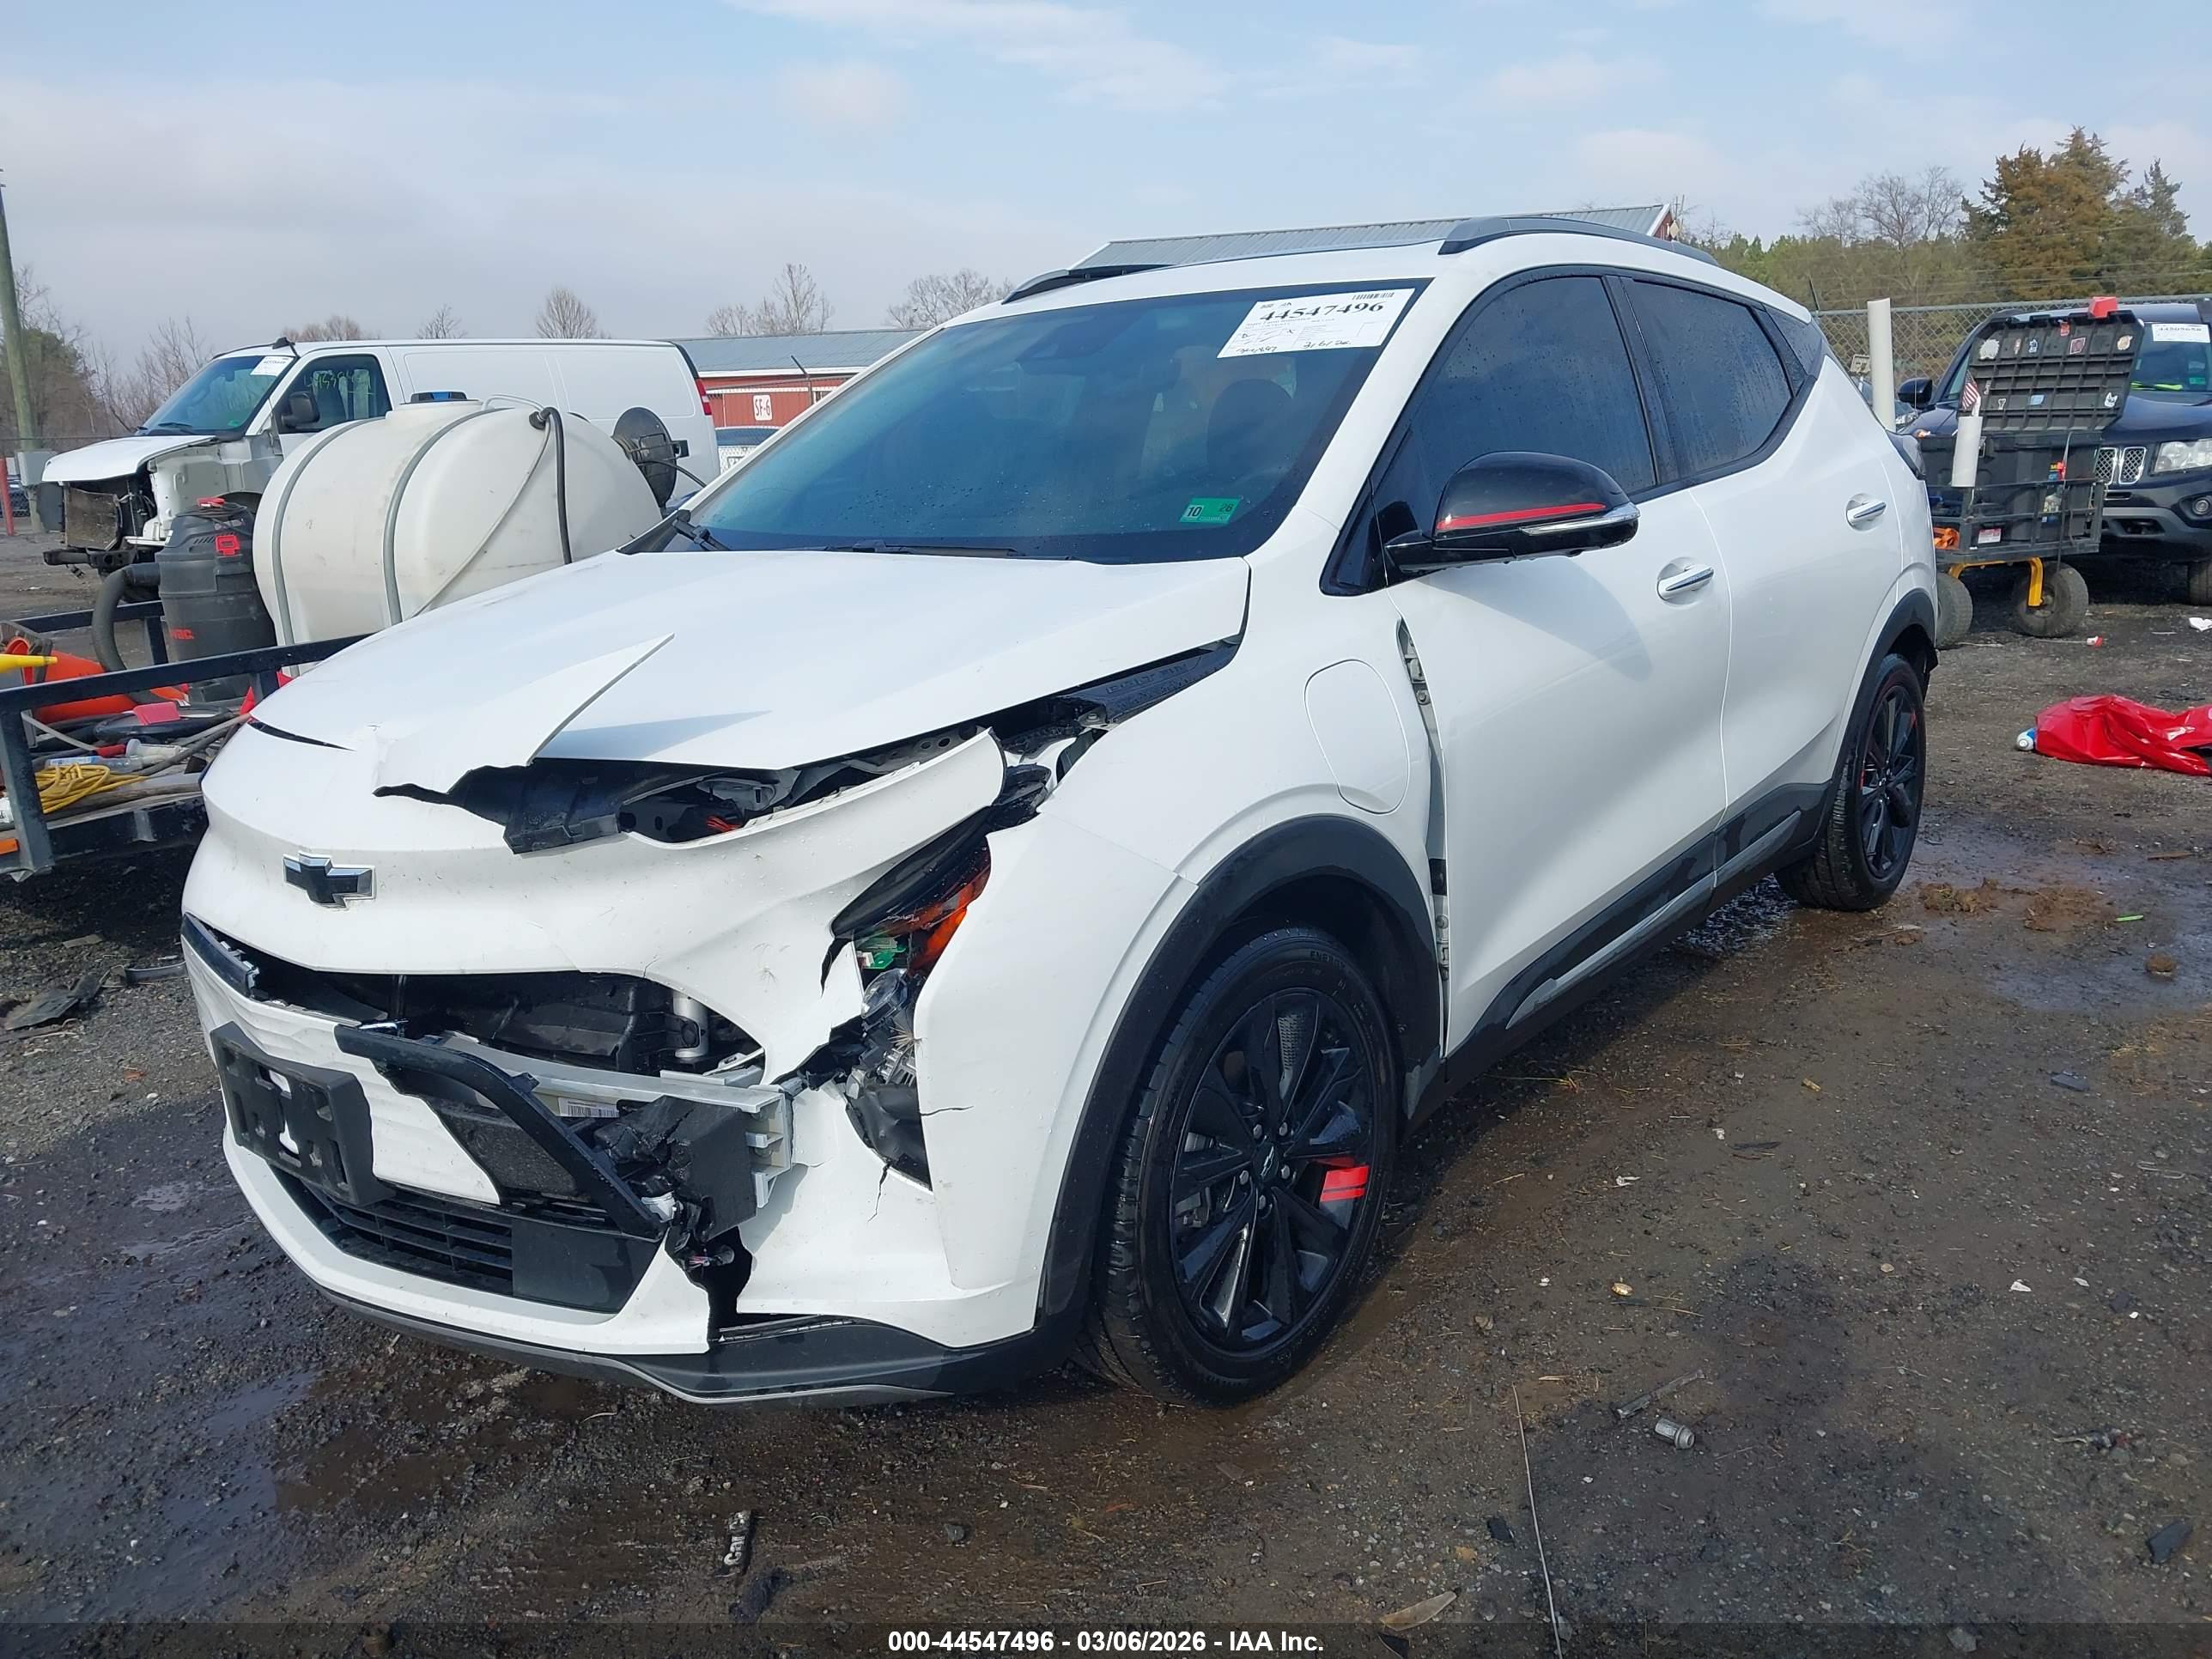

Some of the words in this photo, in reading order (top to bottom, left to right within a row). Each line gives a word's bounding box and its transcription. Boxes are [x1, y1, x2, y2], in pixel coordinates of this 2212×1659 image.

[1260, 301, 1388, 320] 44547496
[754, 398, 771, 416] SF-6
[1187, 506, 1202, 517] 10
